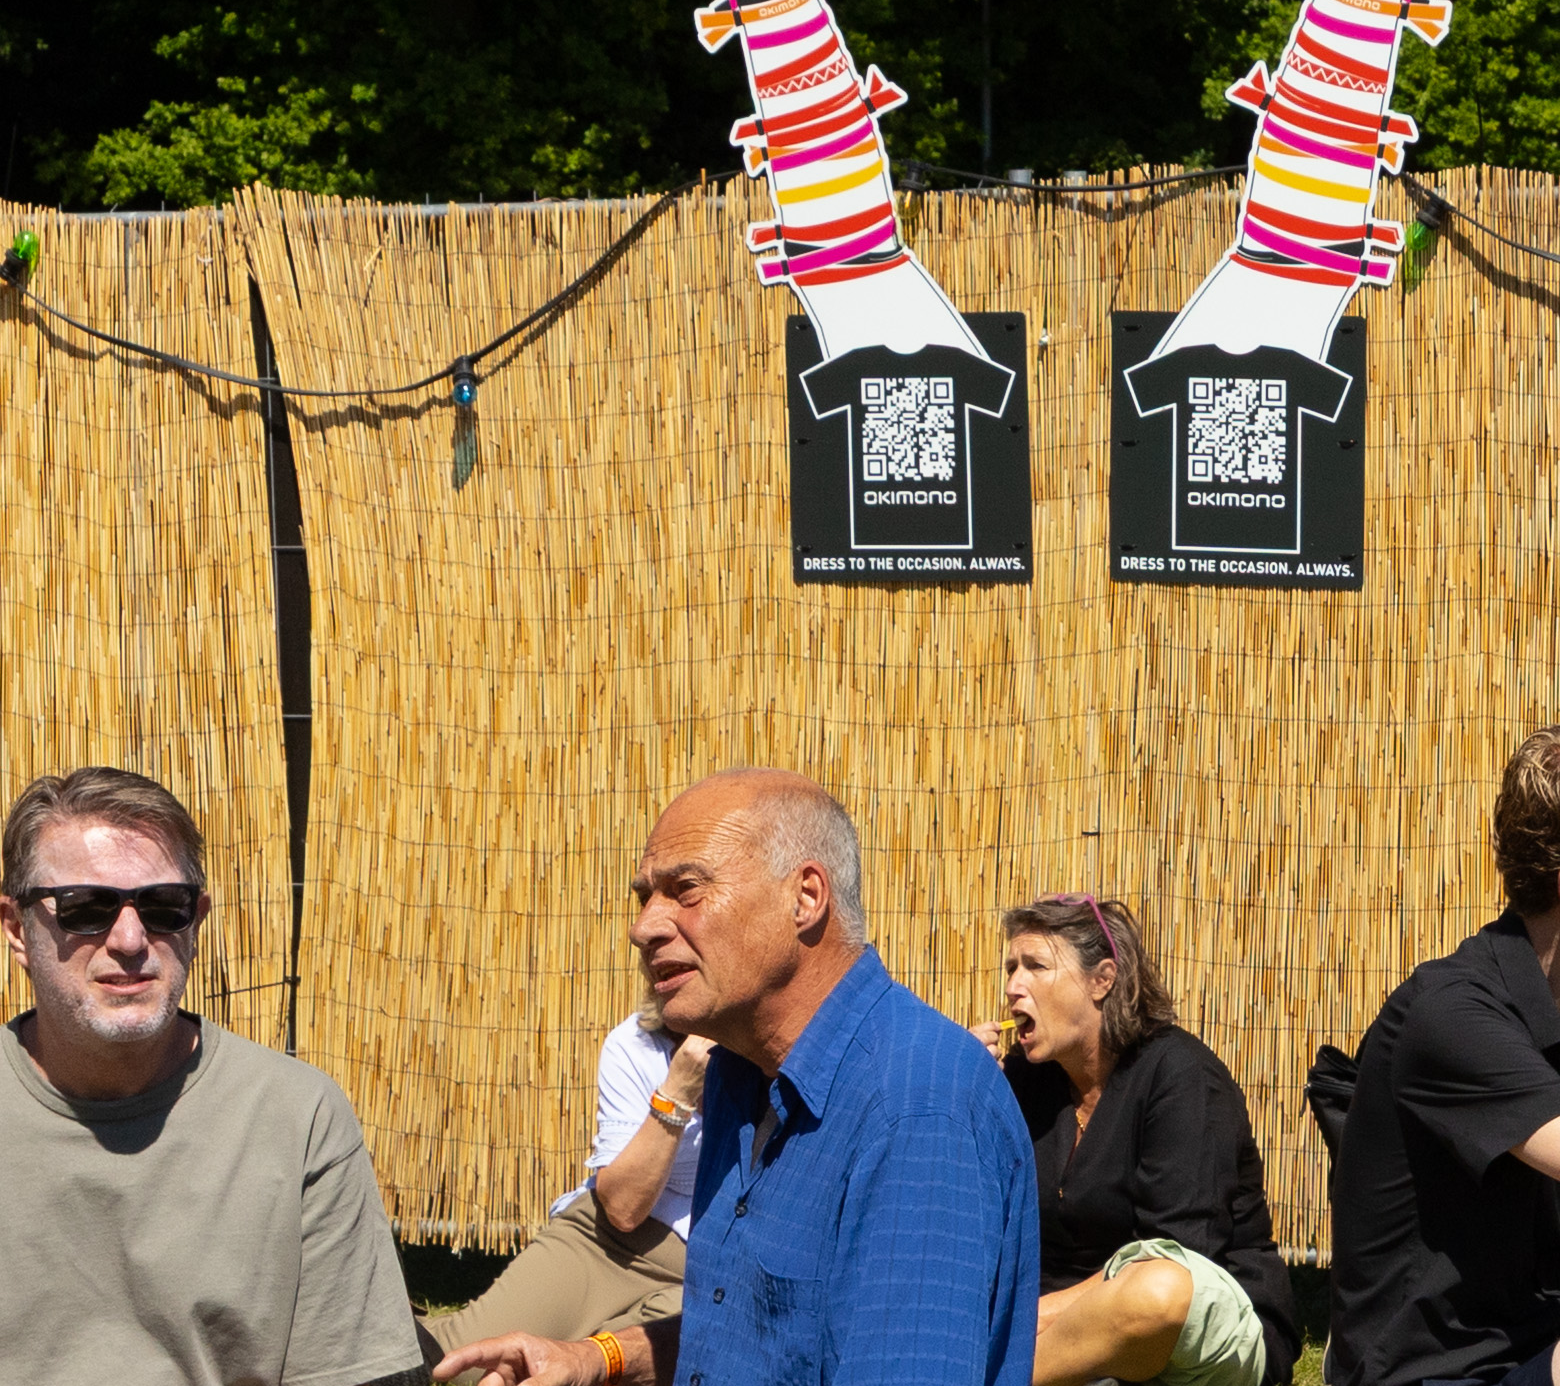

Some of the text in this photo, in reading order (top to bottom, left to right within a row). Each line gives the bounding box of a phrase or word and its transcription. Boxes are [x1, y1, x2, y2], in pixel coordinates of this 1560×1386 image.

[863, 490, 957, 506] OKIMONO
[1187, 491, 1286, 509] OKIMONO
[803, 556, 1026, 571] DRESS TO THE OCCASION. ALWAYS.
[1120, 556, 1355, 578] DRESS TO THE OCCASION. ALWAYS.
